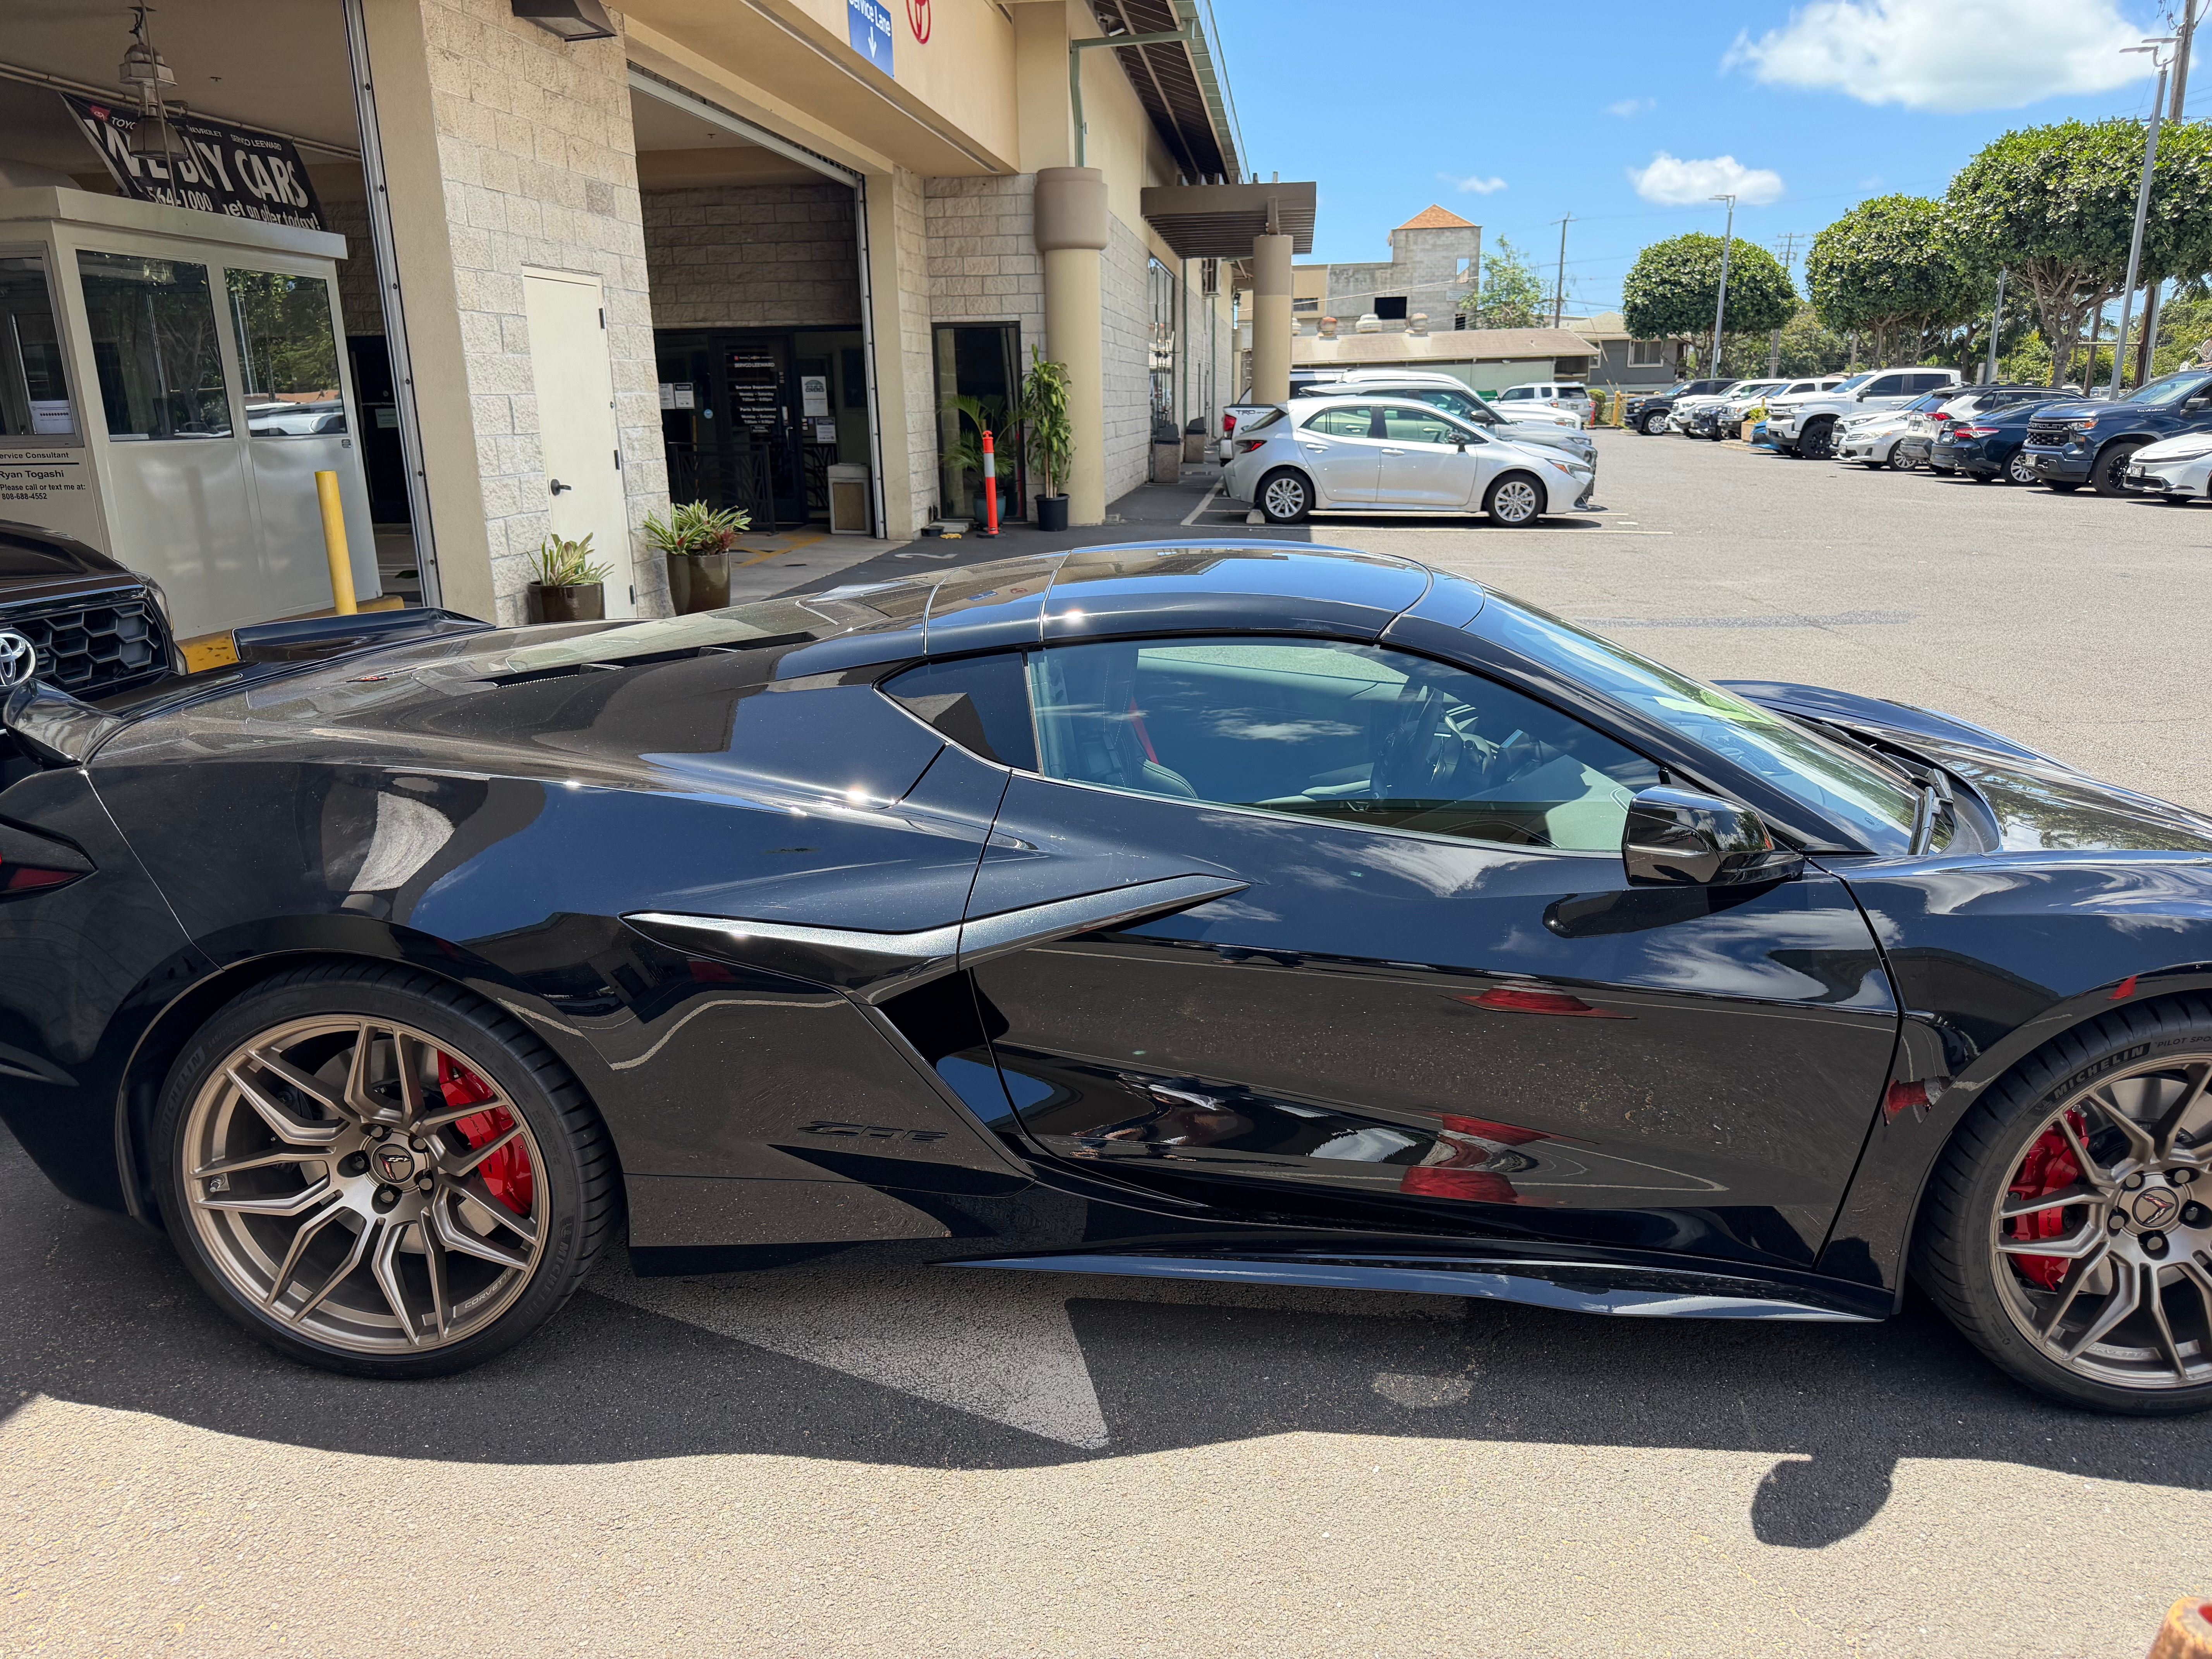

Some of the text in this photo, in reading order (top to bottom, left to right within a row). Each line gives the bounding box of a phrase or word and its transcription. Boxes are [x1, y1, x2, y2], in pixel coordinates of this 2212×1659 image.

[849, 0, 891, 37] ervice Lane
[187, 125, 222, 137] HEVROLET
[251, 140, 282, 151] LEEWARD
[235, 149, 309, 208] CARS
[246, 205, 260, 220] an
[261, 204, 281, 224] offer
[283, 210, 321, 230] today!
[0, 470, 64, 479] Ryan Togashi
[2157, 1037, 2188, 1048] PILOT
[2053, 1046, 2144, 1099] MICHELIN
[162, 1053, 201, 1136] MICHELIN
[464, 1267, 514, 1309] CORVETTE
[514, 1241, 569, 1326] MICHELIN
[2088, 1344, 2151, 1357] ORVETTE
